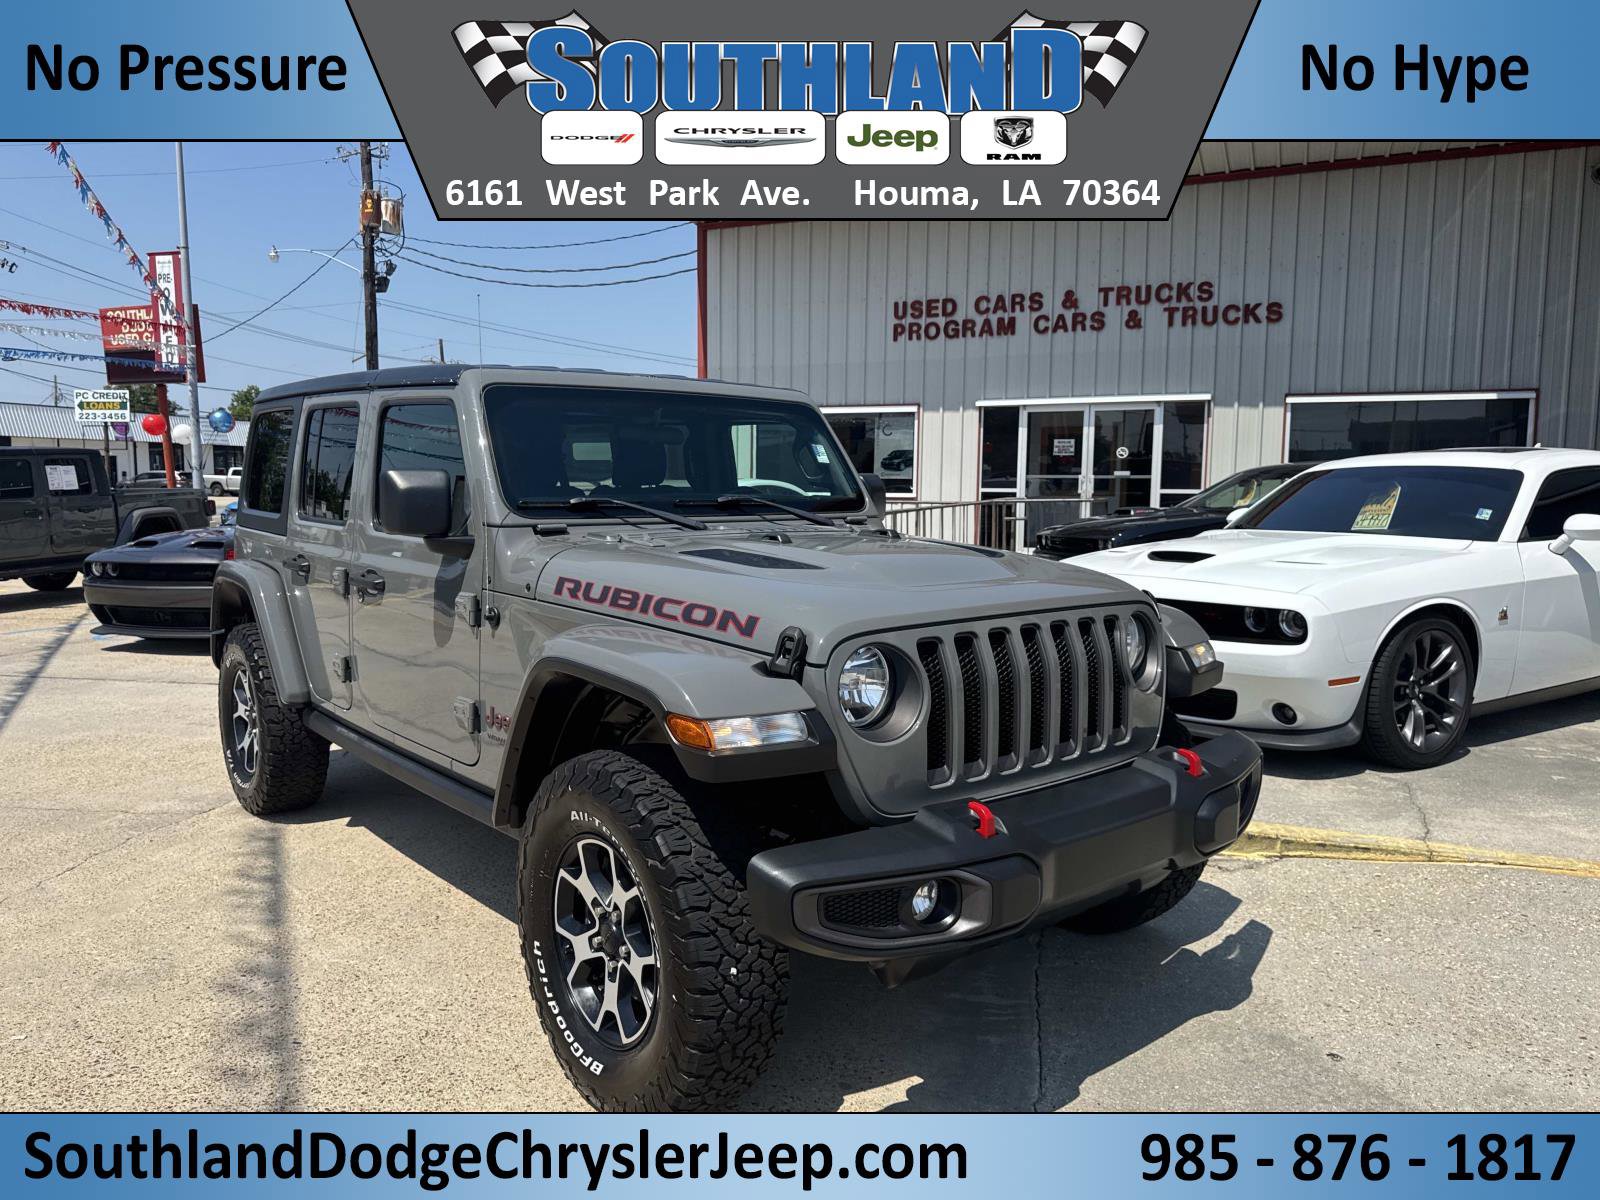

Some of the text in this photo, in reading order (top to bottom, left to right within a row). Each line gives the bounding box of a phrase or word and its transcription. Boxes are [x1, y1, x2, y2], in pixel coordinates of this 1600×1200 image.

[893, 281, 1214, 320] USED CARS & TRUCKS
[892, 302, 1284, 342] PROGRAM CARS & TRUCKS
[75, 391, 128, 400] PC CREDIT
[83, 401, 120, 410] LOANS
[78, 412, 127, 420] 223-3456
[553, 576, 761, 639] RUBICON
[486, 705, 512, 729] Jee
[533, 940, 604, 1076] BFGoodrich
